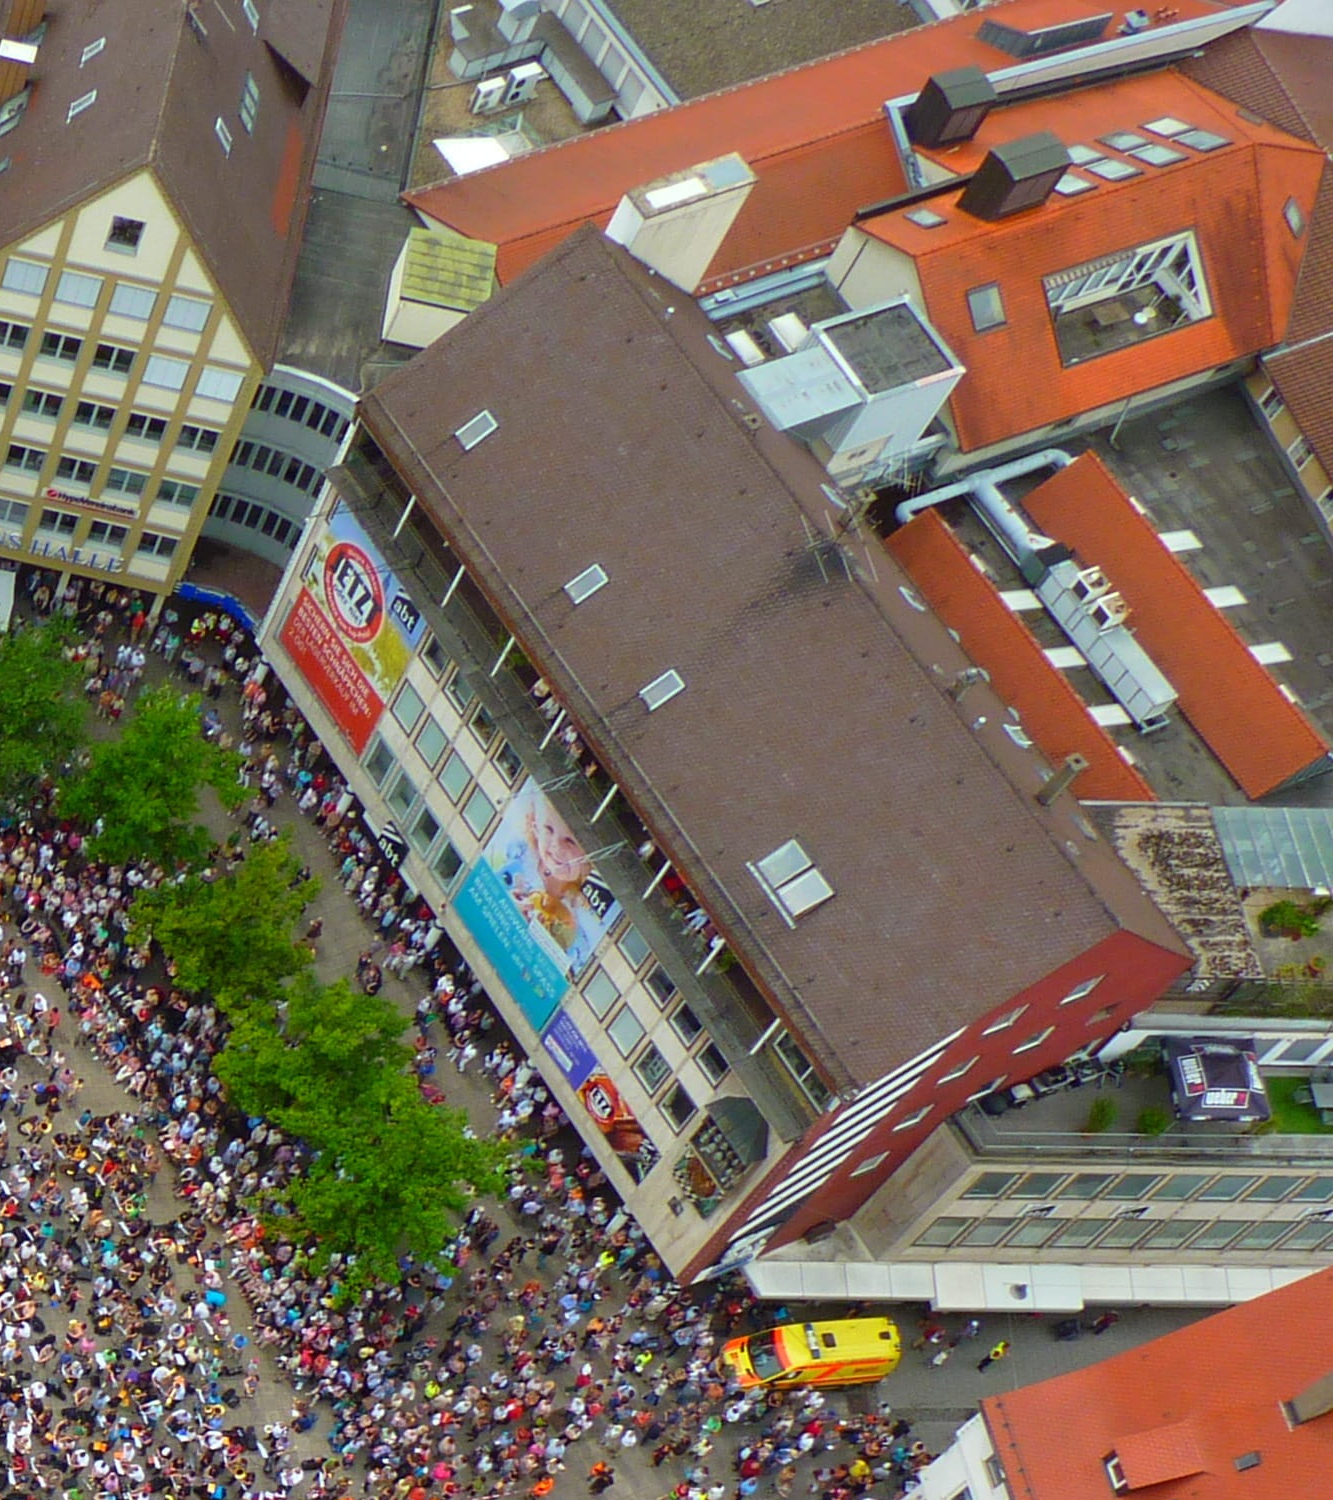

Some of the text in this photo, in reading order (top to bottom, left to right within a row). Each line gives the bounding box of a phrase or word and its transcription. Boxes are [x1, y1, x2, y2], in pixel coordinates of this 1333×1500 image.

[29, 539, 125, 573] HALLE
[331, 551, 383, 625] JETZT
[297, 606, 324, 645] BESTEN
[303, 596, 331, 641] SICHERN
[394, 600, 415, 630] abt
[378, 838, 399, 867] abt
[582, 885, 606, 916] abt
